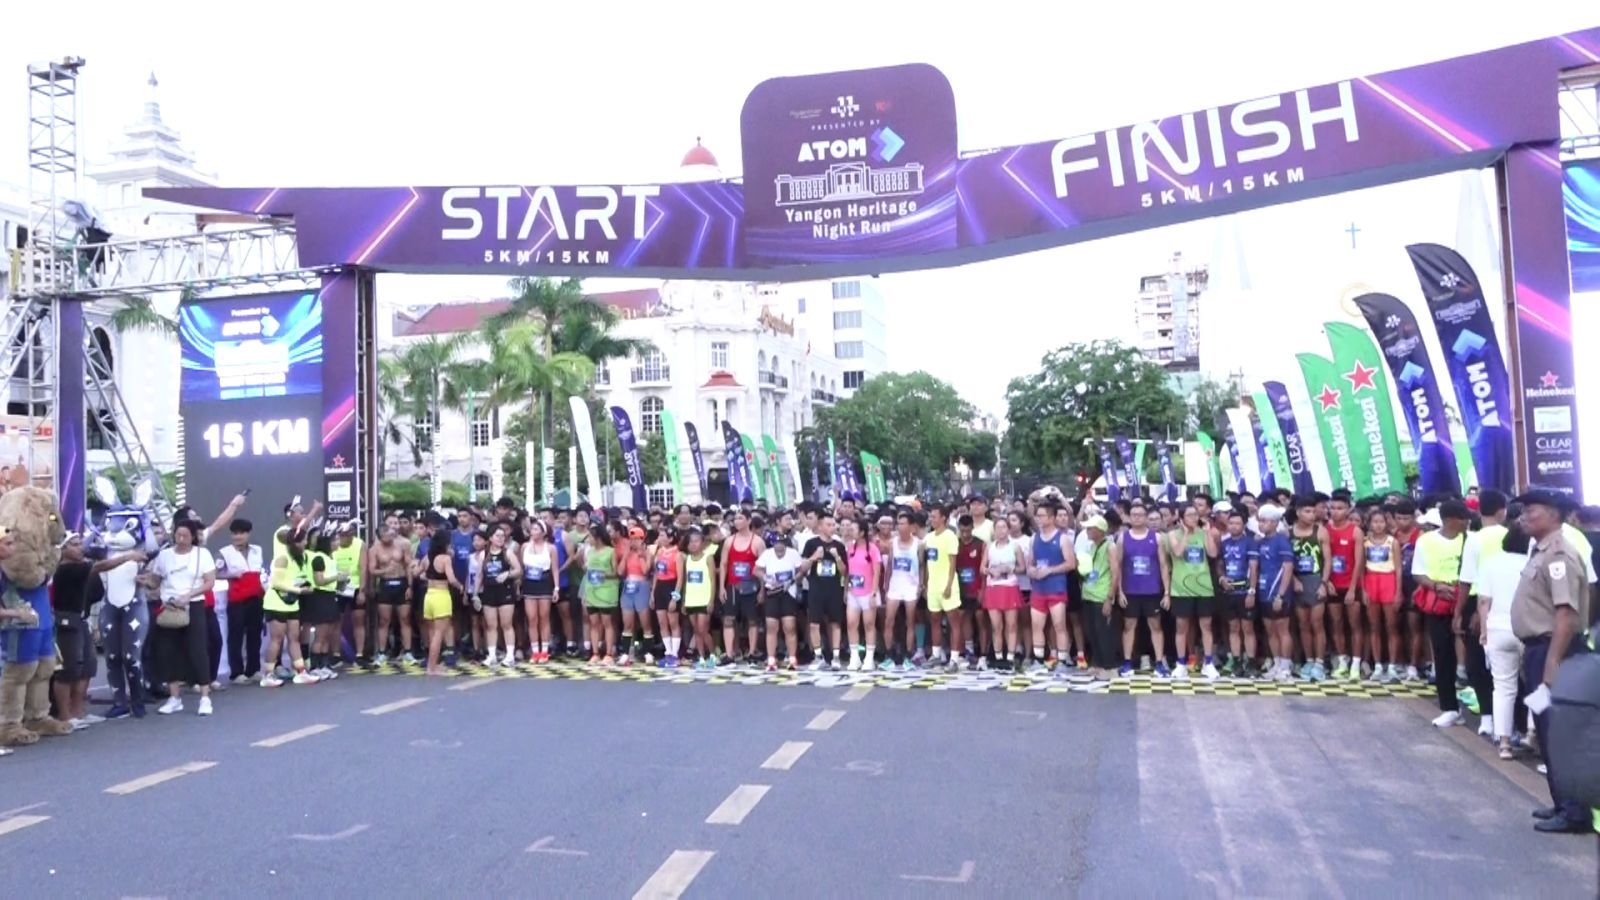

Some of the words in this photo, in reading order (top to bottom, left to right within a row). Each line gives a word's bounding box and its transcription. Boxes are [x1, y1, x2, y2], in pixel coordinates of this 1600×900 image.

[811, 120, 864, 130] PRESENTED
[1051, 80, 1359, 198] FINISH
[798, 137, 867, 162] ATOM
[441, 186, 661, 240] START
[785, 206, 842, 223] Yangon
[848, 200, 917, 219] Heritage
[813, 222, 856, 240] Night
[861, 221, 892, 234] Run
[1466, 361, 1500, 427] ATOM
[1525, 387, 1577, 398] Heineken
[1411, 387, 1437, 442] ATOM
[203, 422, 244, 459] 15
[252, 417, 310, 455] KM
[1287, 432, 1303, 474] CLEAR
[1359, 397, 1390, 489] Heineken
[1536, 437, 1572, 449] CLEAR
[625, 451, 639, 486] CLEAR
[328, 504, 351, 514] CLEAR
